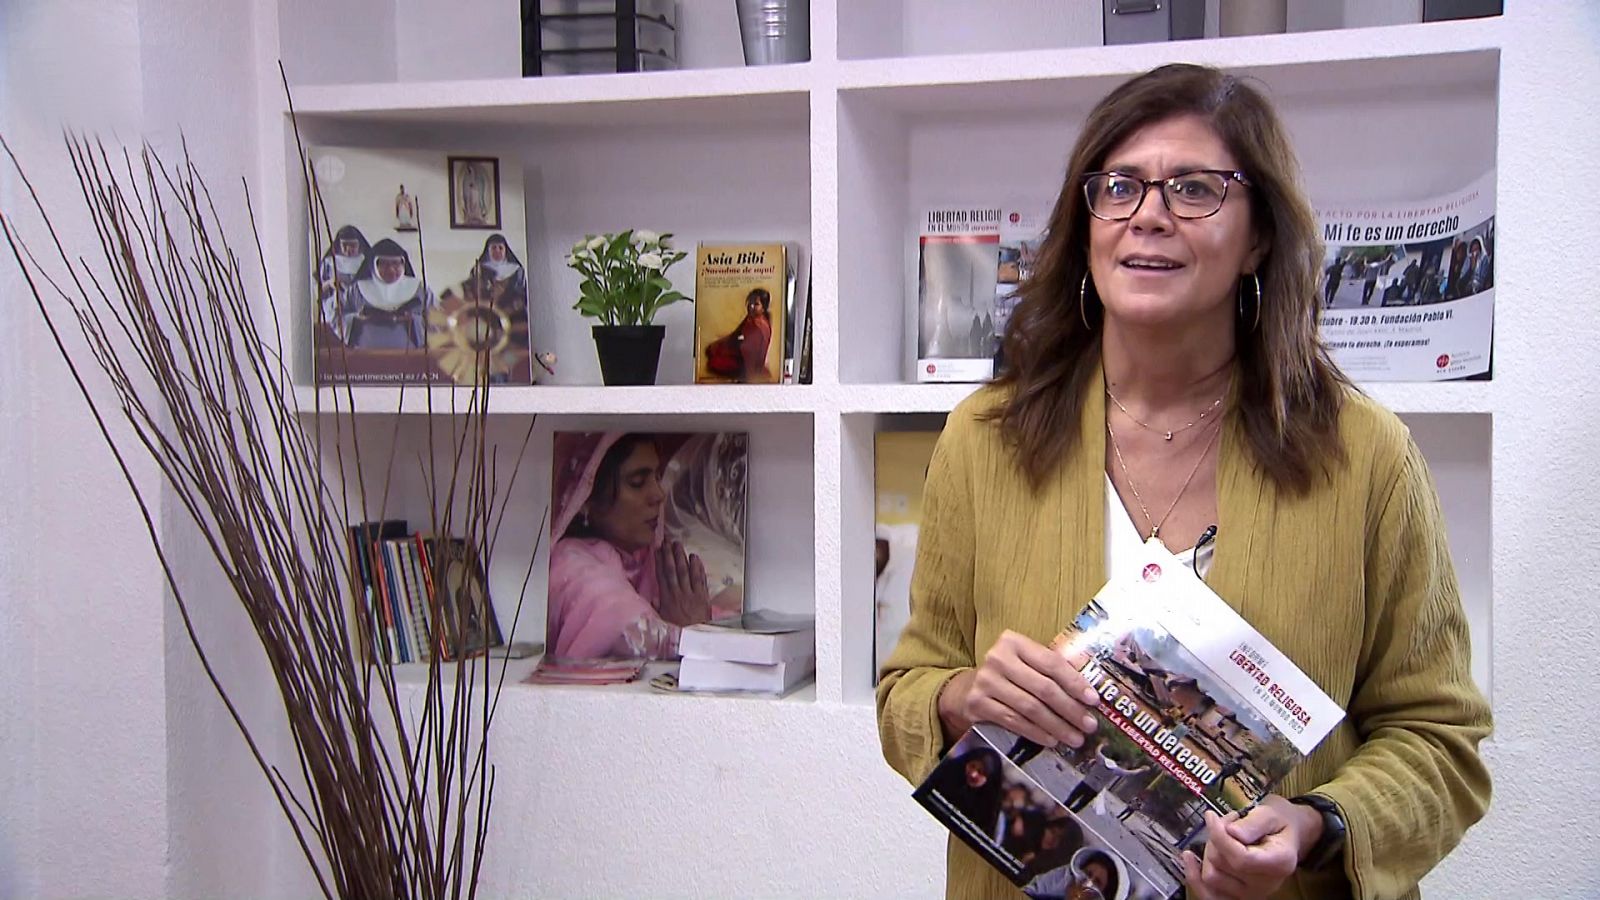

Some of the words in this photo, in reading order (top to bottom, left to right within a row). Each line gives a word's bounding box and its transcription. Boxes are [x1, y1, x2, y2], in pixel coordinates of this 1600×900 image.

[928, 210, 967, 223] LIBERTAD
[1326, 210, 1352, 218] ACTO
[1357, 210, 1377, 219] POR
[1397, 206, 1442, 219] LIBERTAD
[1324, 222, 1342, 240] Mi
[1347, 223, 1361, 240] fe
[1365, 226, 1382, 240] es
[1385, 226, 1403, 240] un
[1407, 215, 1459, 239] derecho
[703, 252, 732, 265] Asia
[737, 251, 765, 265] Bibi
[742, 265, 752, 274] de
[1380, 313, 1421, 324] Fundación
[1423, 310, 1445, 322] Pablo
[1229, 650, 1270, 686] LIBERTAD
[1268, 683, 1311, 726] RELIGIOSA
[1098, 678, 1119, 701] fe
[1114, 695, 1137, 718] es
[1133, 710, 1159, 734] un
[1154, 725, 1217, 785] derecho
[1109, 713, 1121, 726] LA
[1120, 722, 1160, 756] LIBERTAD
[1159, 755, 1203, 796] RELIGIOSA
